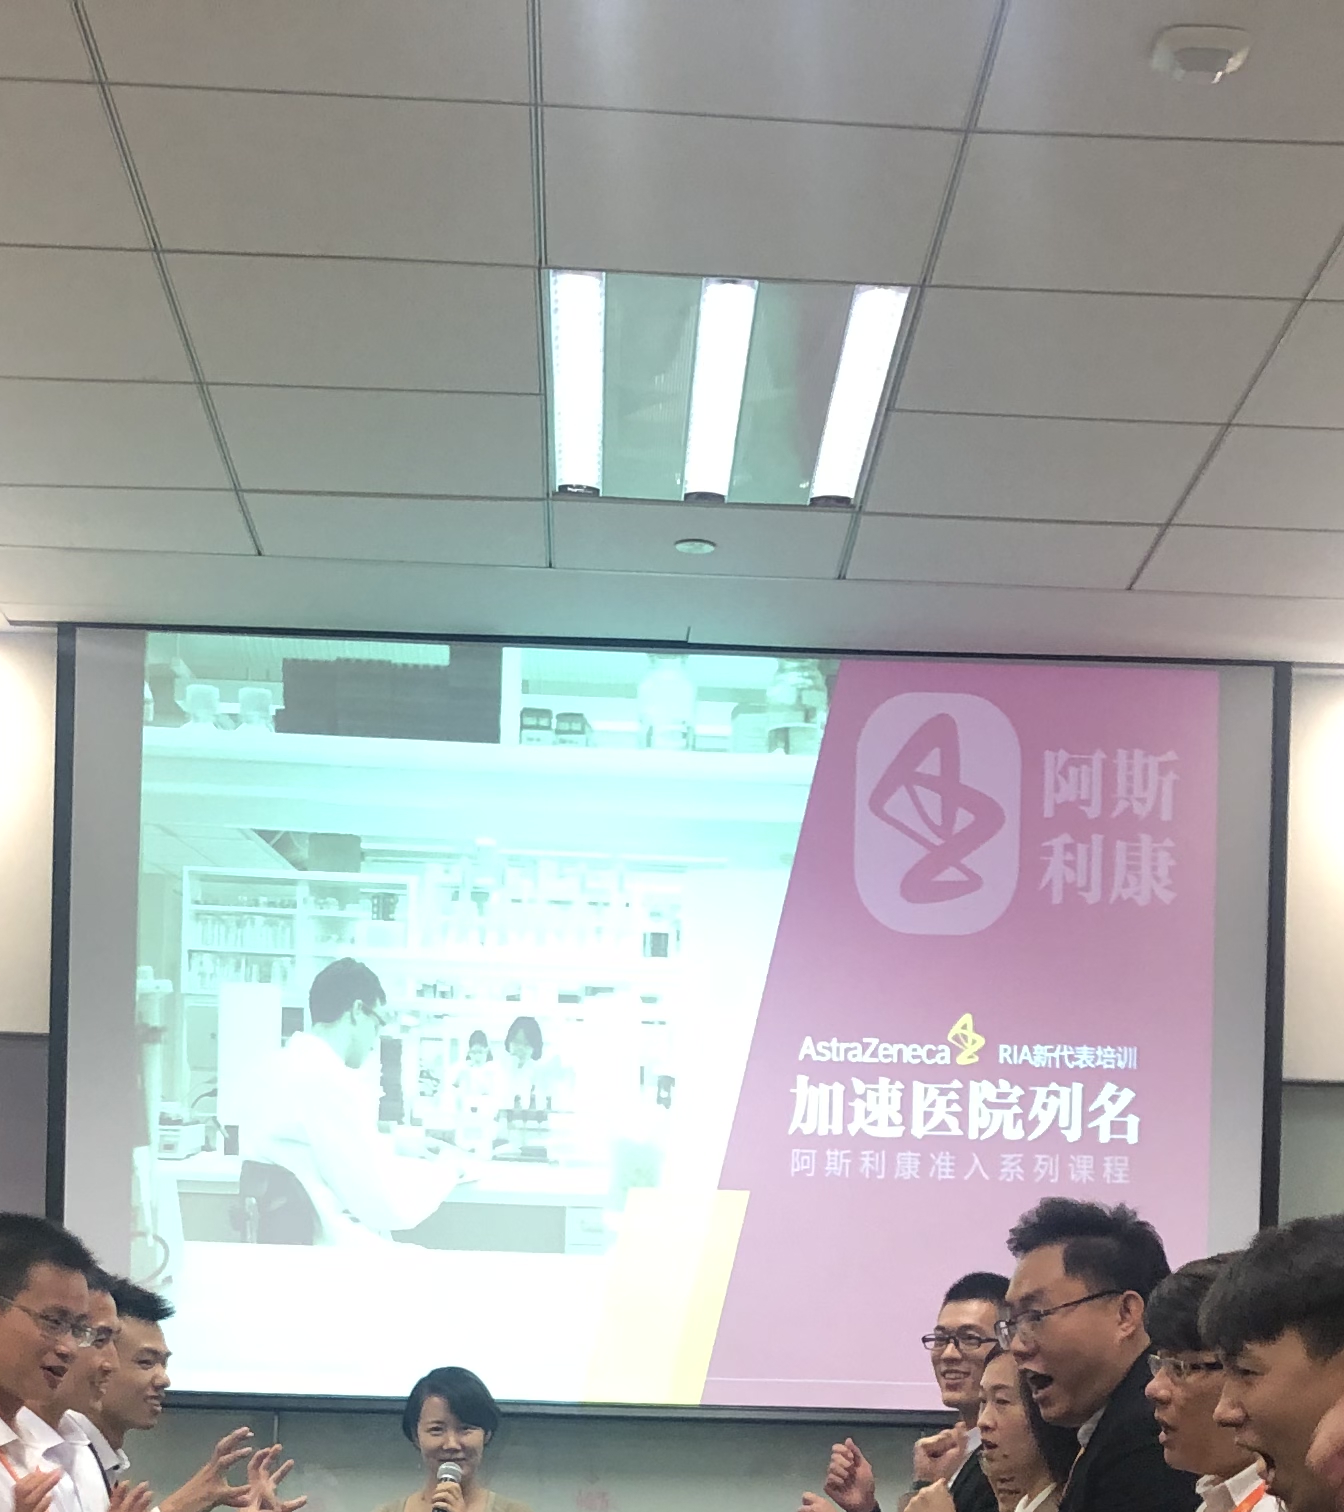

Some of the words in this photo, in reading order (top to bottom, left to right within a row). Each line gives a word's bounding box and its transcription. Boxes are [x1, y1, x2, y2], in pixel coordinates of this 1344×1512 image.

[1043, 748, 1180, 821] 阿斯
[1039, 832, 1178, 906] 利康
[798, 1035, 951, 1065] AstraZeneca
[998, 1044, 1138, 1070] RIA新代表培训
[787, 1074, 1141, 1145] 加速医院列名
[790, 1149, 1132, 1185] 阿斯利康准入系列课程
